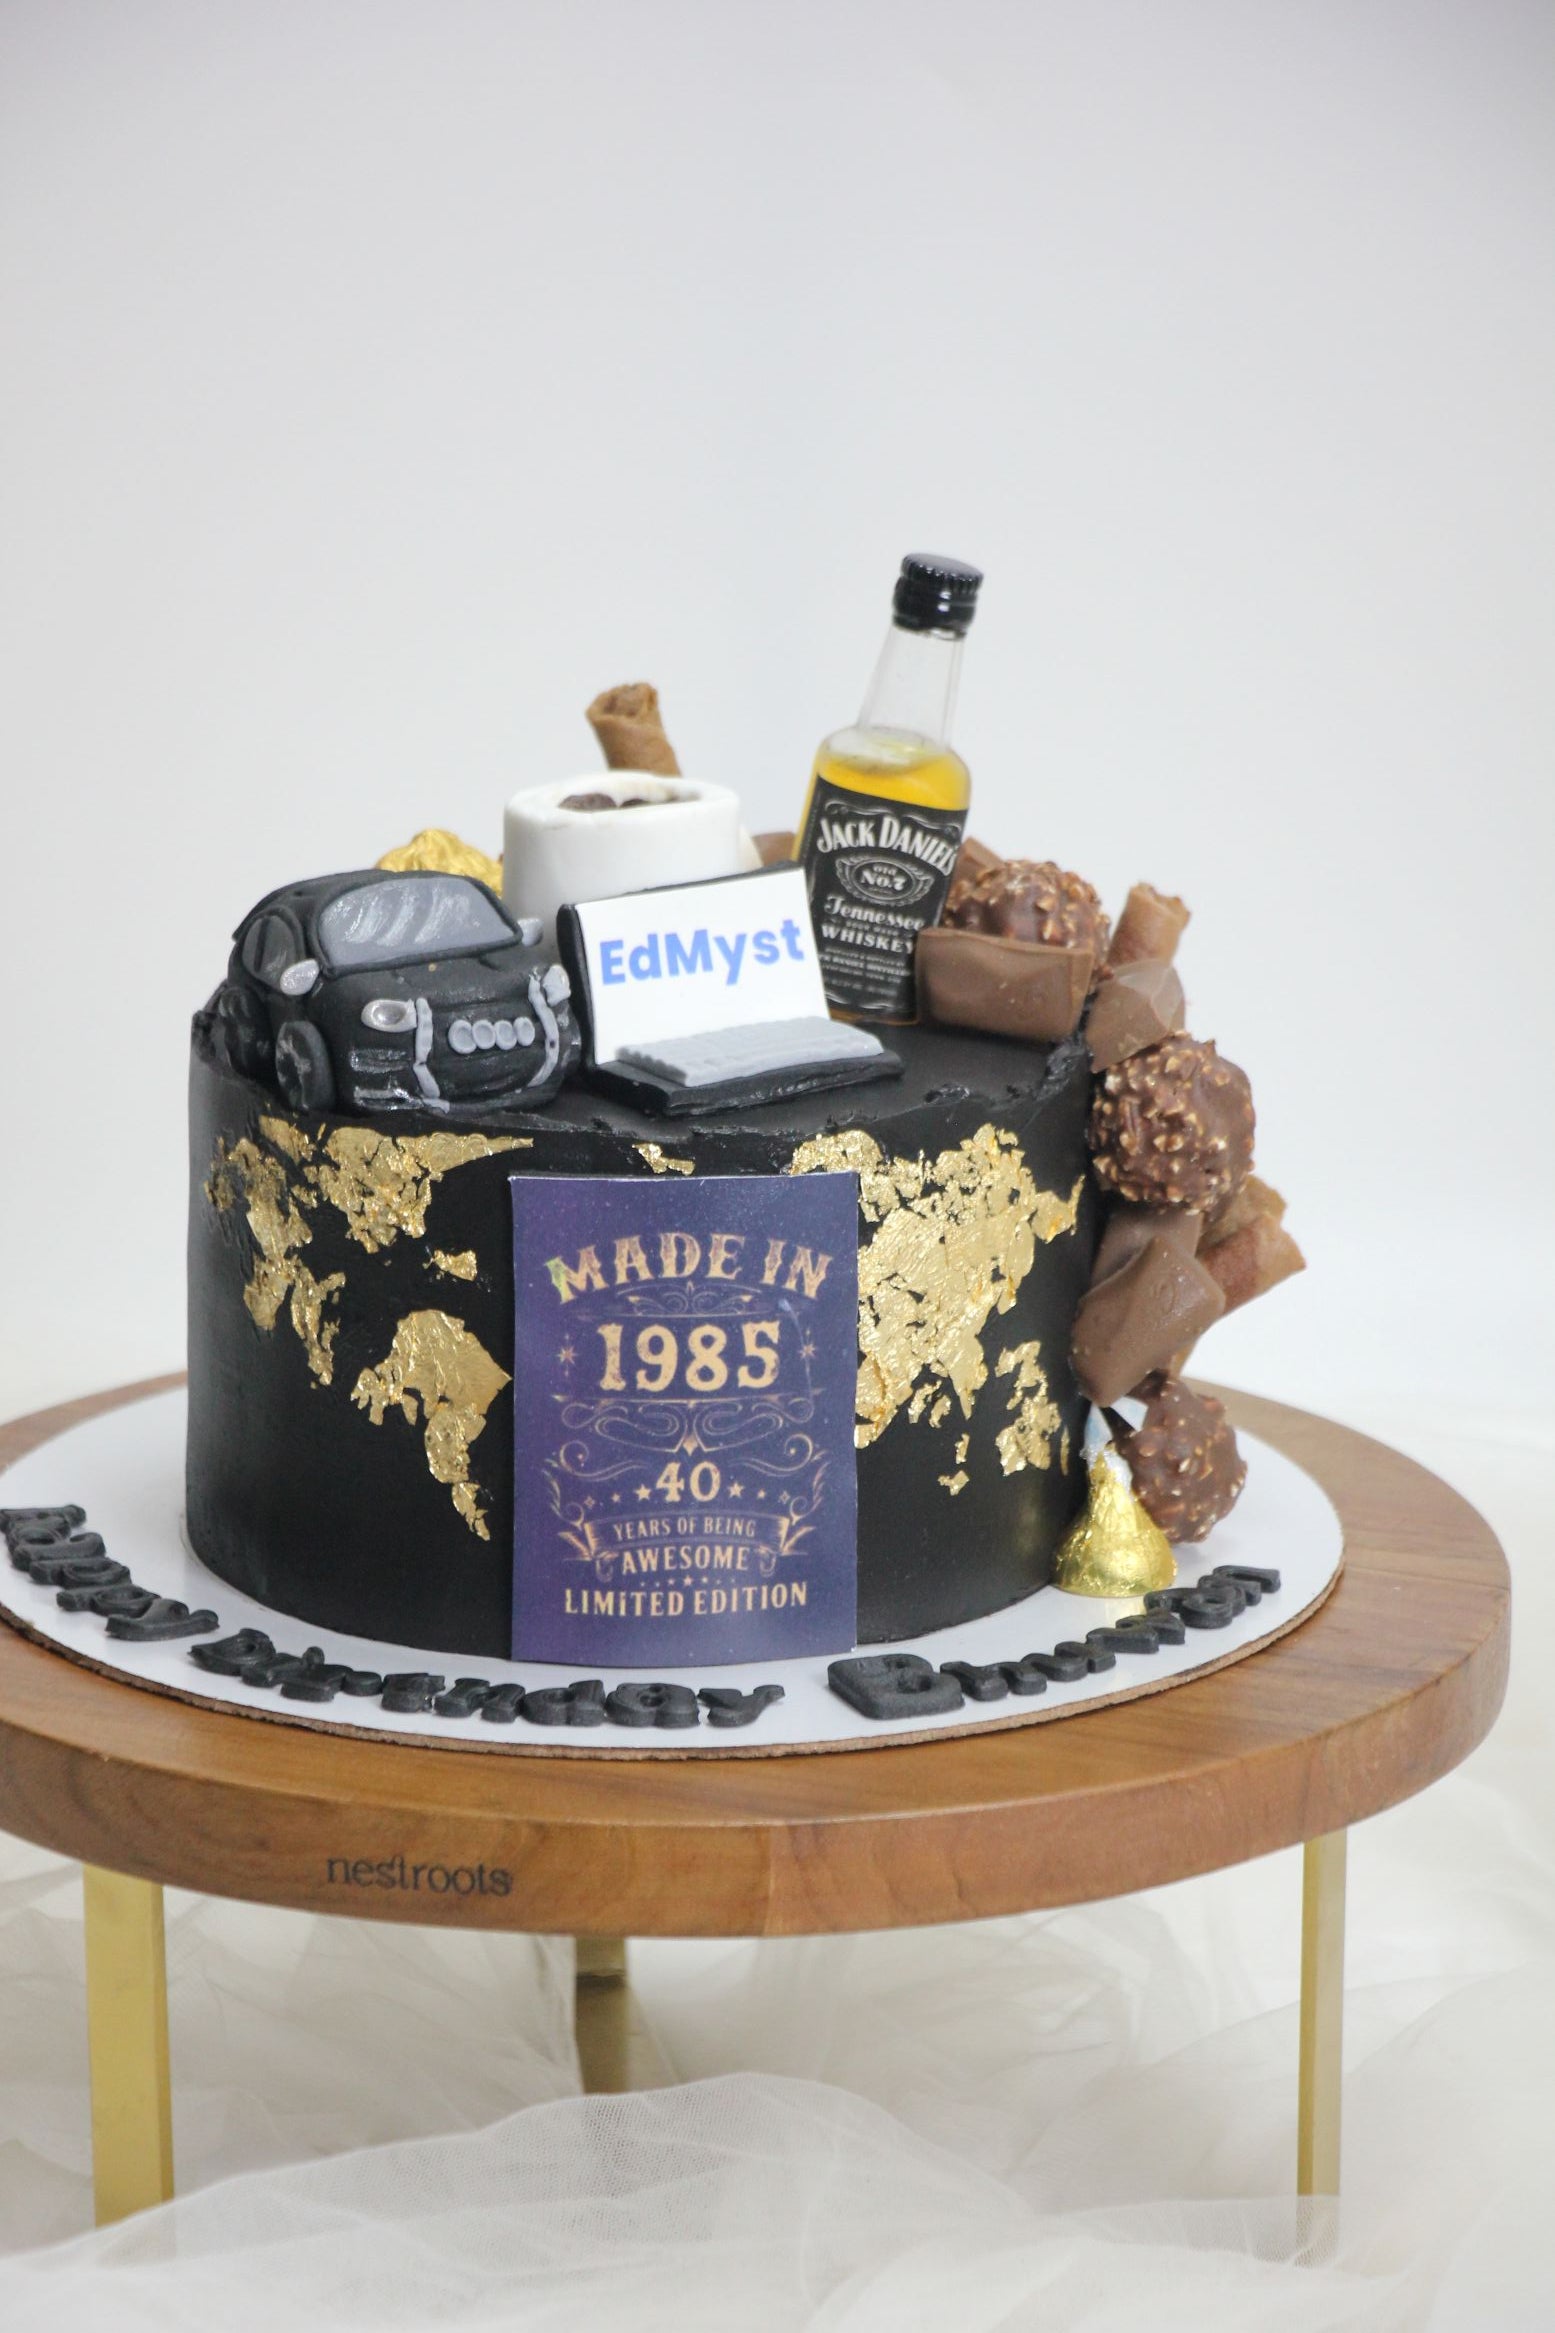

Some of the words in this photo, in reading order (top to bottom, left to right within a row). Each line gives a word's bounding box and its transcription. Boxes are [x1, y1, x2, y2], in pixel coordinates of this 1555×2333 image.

[816, 817, 877, 854] JACK
[823, 894, 925, 931] Tennessee
[599, 918, 805, 986] EdMyst
[544, 1232, 745, 1304] MADE
[759, 1238, 833, 1299] IN
[596, 1320, 781, 1392] 1985
[656, 1461, 722, 1502] 40
[613, 1518, 671, 1542] YEARS
[676, 1516, 698, 1536] OF
[703, 1515, 757, 1538] BEING
[622, 1545, 749, 1575] AWESOME
[564, 1589, 684, 1617] LIMITED
[694, 1581, 807, 1615] EDITION
[326, 1854, 513, 1897] nestroots
